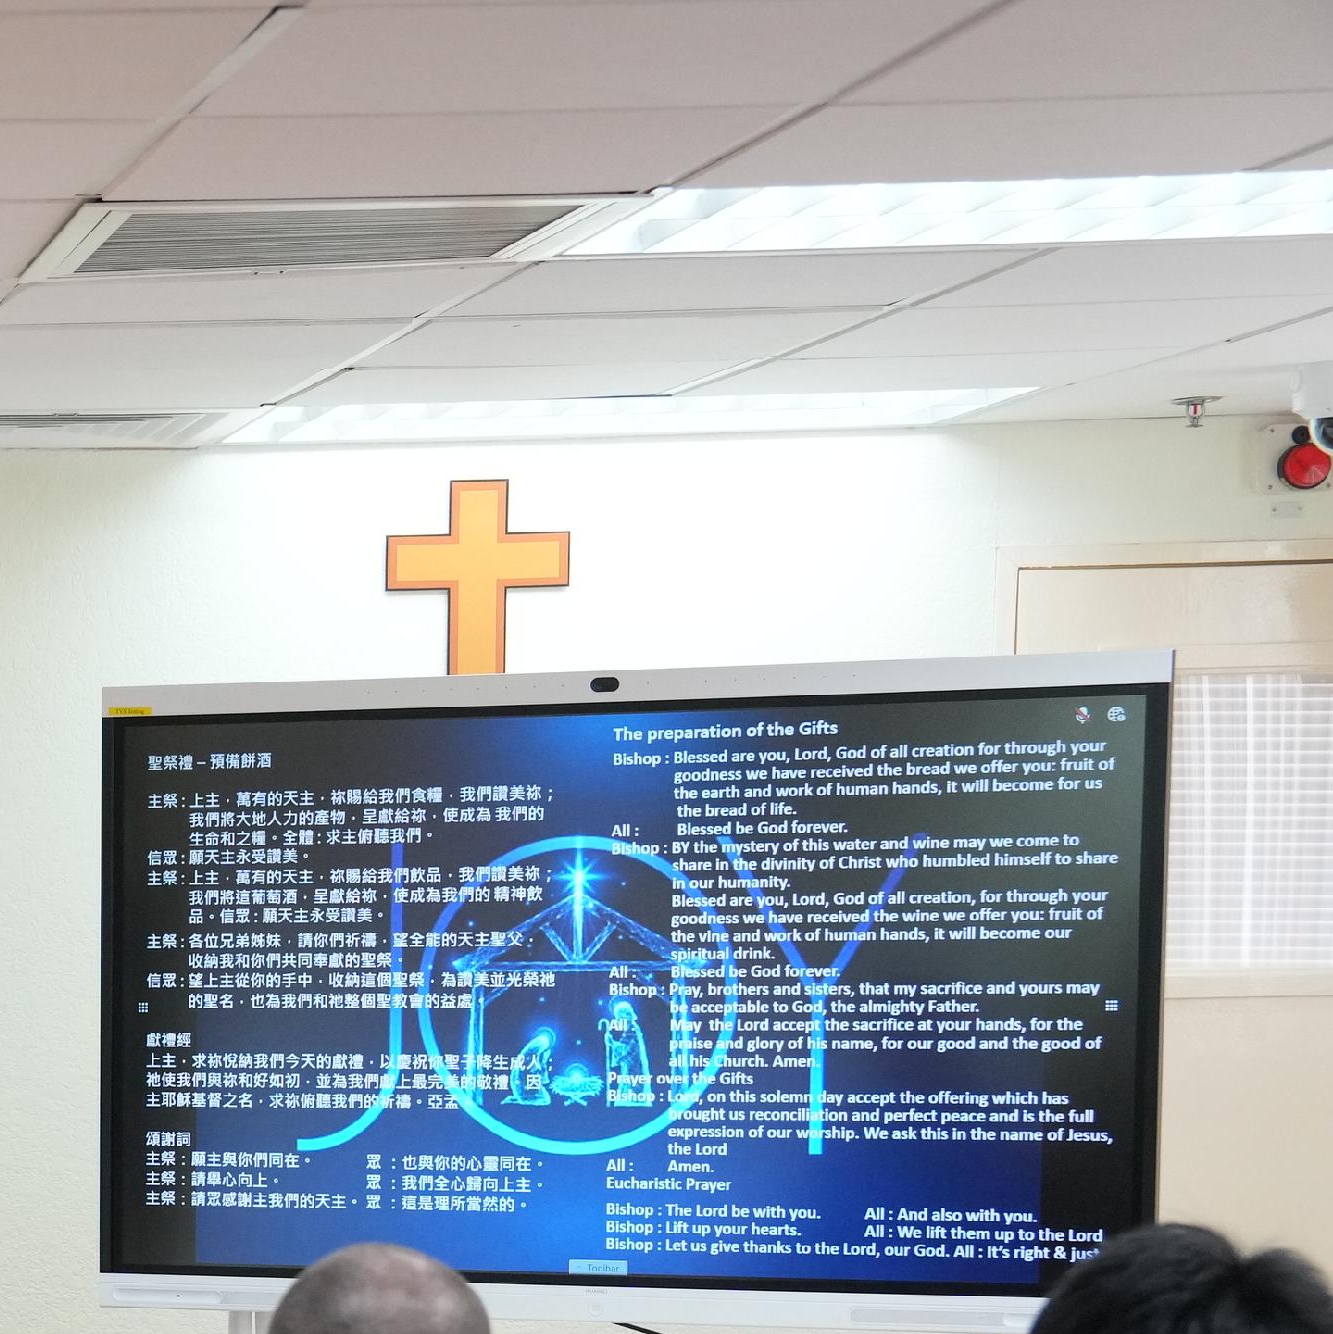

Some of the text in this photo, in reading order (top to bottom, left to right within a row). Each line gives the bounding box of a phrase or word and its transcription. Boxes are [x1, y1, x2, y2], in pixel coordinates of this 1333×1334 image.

[614, 721, 839, 743] The preparation of the Gifts
[148, 752, 272, 771] 聖祭禮 預備餅酒
[614, 739, 1108, 768] Bishop Blessed are you, Lord, God of all creation for through your
[674, 757, 1115, 784] goodness we have received the bread we offer you: fruit of
[674, 776, 1103, 799] the earth and work of human hands, it will become for us
[677, 802, 797, 817] the bread of life.
[612, 824, 631, 837] All
[678, 820, 848, 835] Blessed be God forever.
[146, 1032, 191, 1048] 獻禮經
[145, 1131, 191, 1147] 頌謝詞
[668, 1124, 1113, 1144] expression of our worship. We ask this in the name of Jesus,
[668, 1142, 728, 1156] the Lord
[606, 1158, 626, 1172] All
[668, 1158, 715, 1173] Amen.
[607, 1175, 732, 1193] Eucharistic Prayer
[607, 1201, 821, 1222] Bishop The Lord be with you.
[864, 1206, 1038, 1226] All And also with you.
[606, 1219, 802, 1238] Bishop Lift up your hearts.
[864, 1224, 1103, 1243] All We lift them up to the Lord
[606, 1236, 654, 1253] Bishop
[666, 1237, 688, 1251] Let
[691, 1240, 708, 1252] us
[711, 1238, 740, 1255] give
[743, 1238, 792, 1253] thanks
[796, 1239, 812, 1254] to
[815, 1240, 840, 1254] the
[844, 1240, 881, 1258] Lord,
[885, 1244, 912, 1256] our
[914, 1242, 951, 1256] God.
[953, 1243, 975, 1257] All
[1014, 1244, 1051, 1261] right
[1054, 1245, 1067, 1259] &
